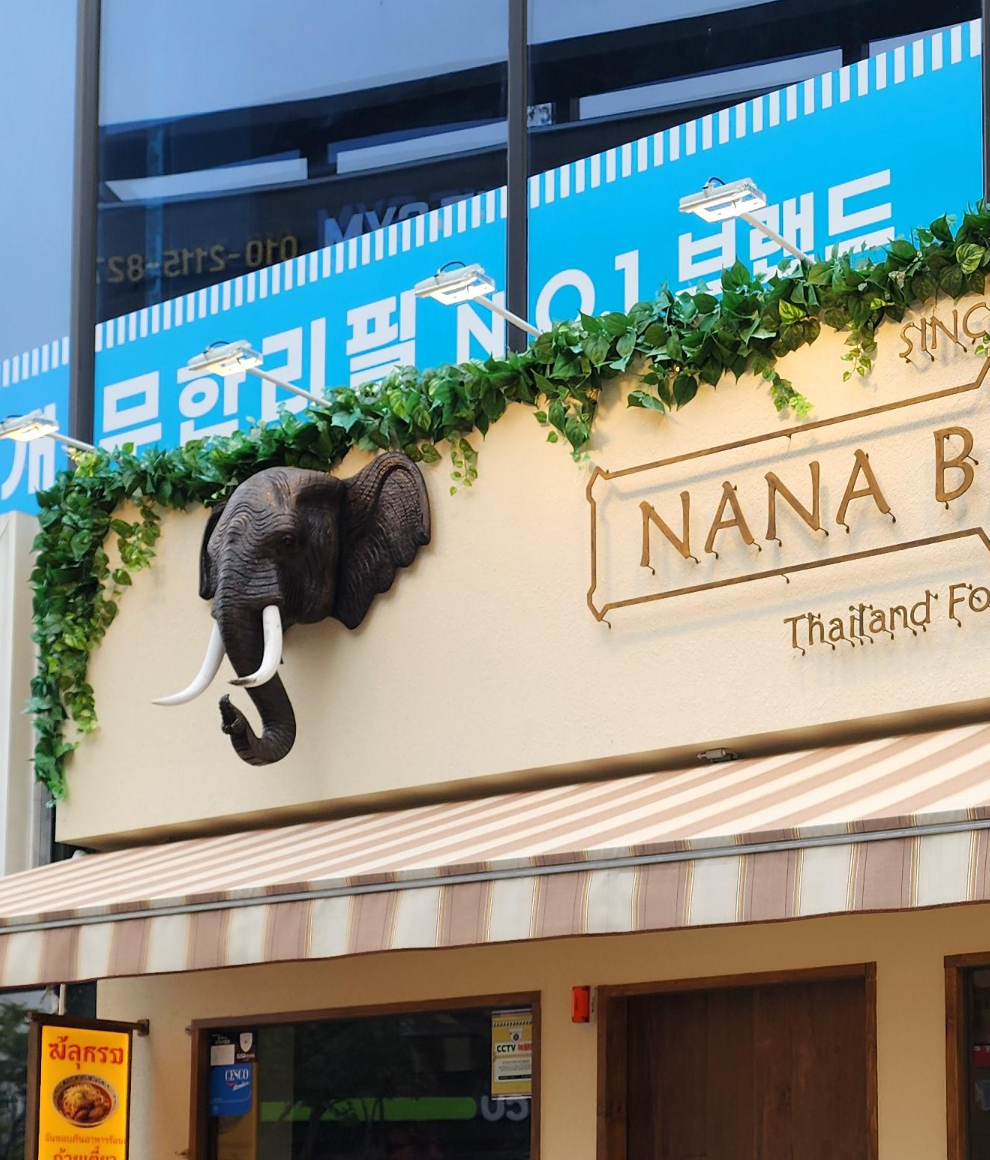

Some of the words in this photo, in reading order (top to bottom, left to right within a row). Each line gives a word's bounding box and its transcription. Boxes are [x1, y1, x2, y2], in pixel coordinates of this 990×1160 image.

[640, 446, 894, 574] NANA
[784, 590, 935, 656] Thailand
[496, 1044, 516, 1053] CCTV
